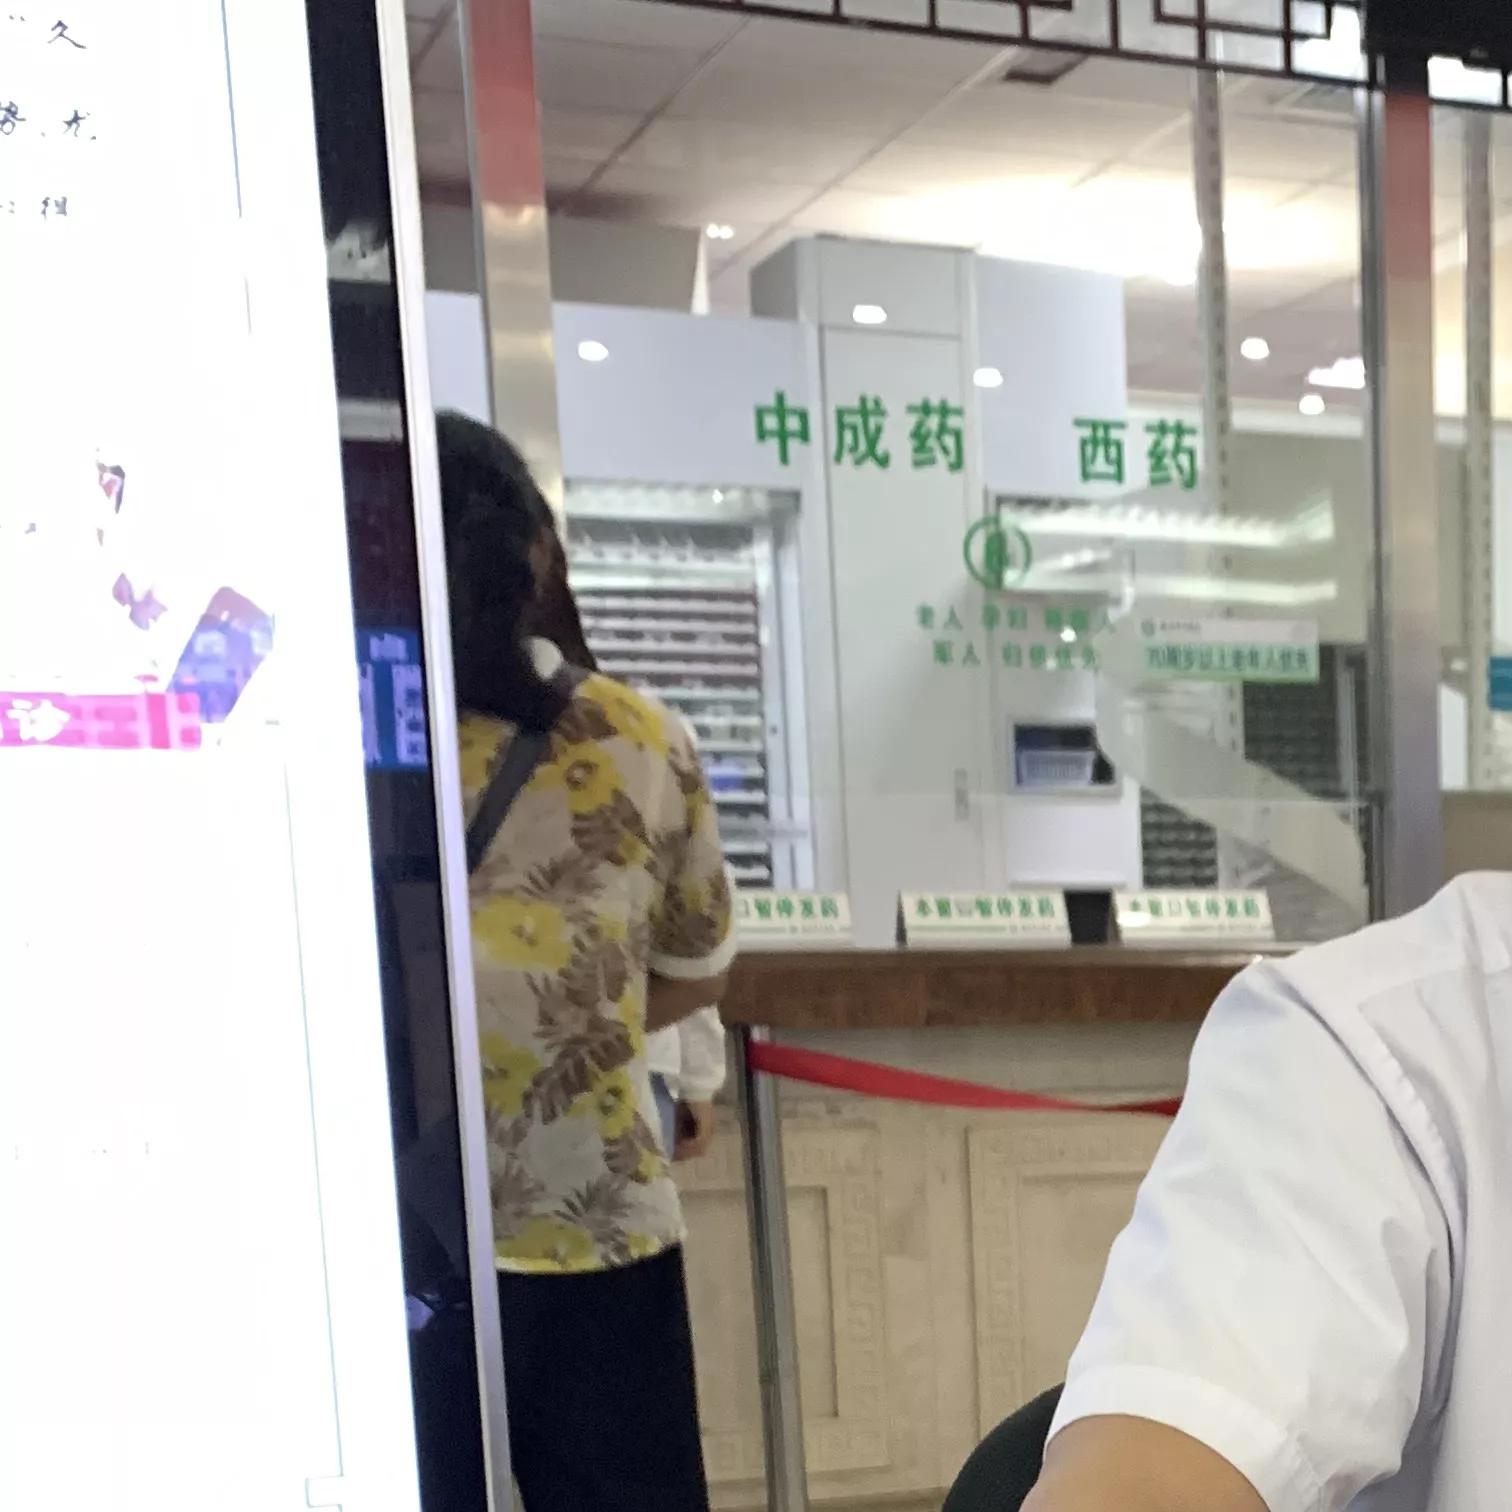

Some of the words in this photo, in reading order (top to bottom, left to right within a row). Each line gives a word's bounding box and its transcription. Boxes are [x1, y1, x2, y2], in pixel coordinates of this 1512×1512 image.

[755, 391, 966, 472] 中成药
[1073, 417, 1200, 490] 西药
